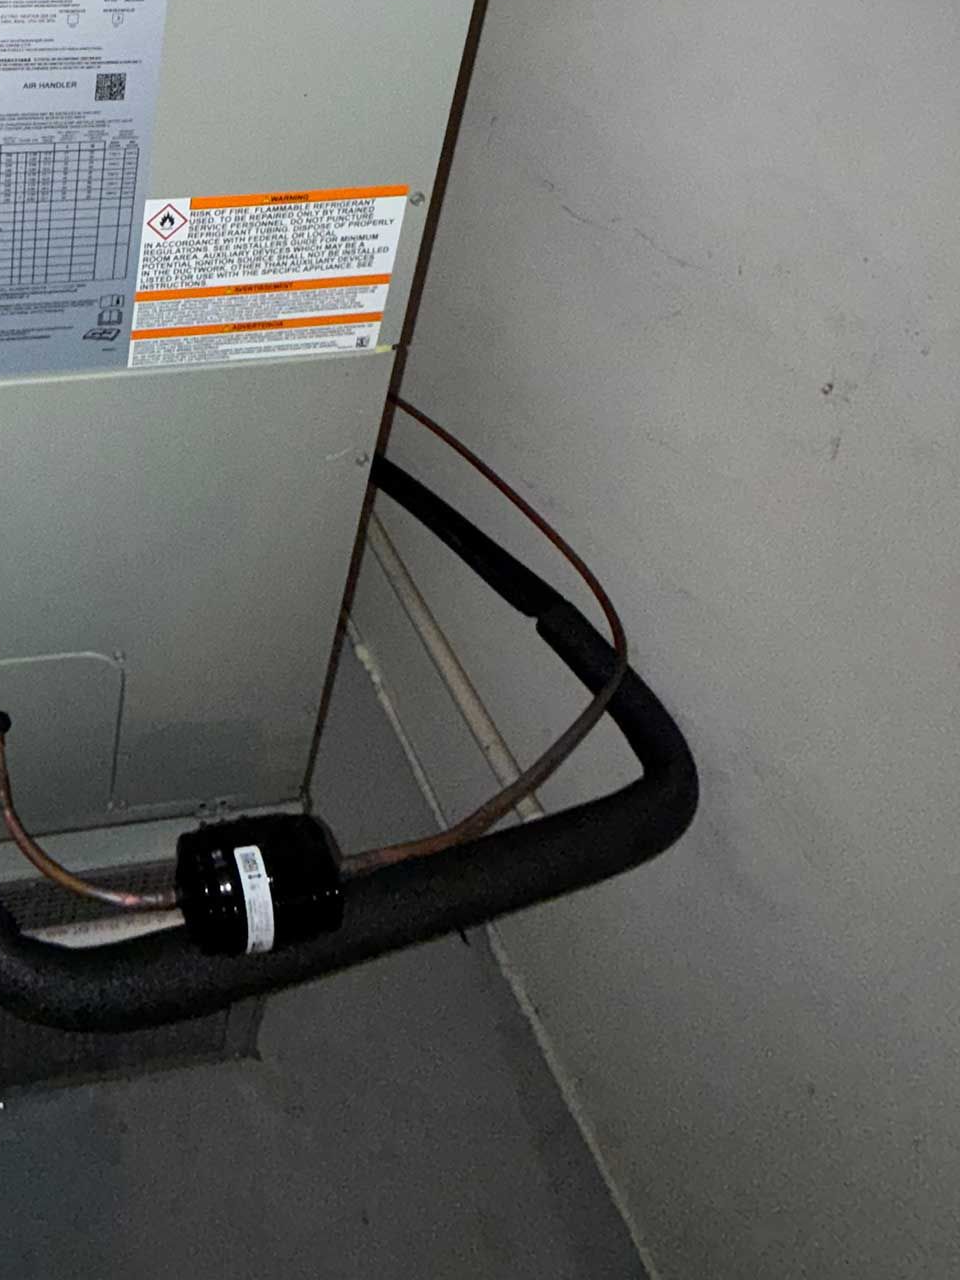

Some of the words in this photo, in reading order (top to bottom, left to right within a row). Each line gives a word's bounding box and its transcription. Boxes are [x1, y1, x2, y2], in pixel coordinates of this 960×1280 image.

[39, 81, 78, 89] HANDLER
[271, 194, 308, 202] WARNING
[249, 211, 294, 220] REPAIRED
[338, 206, 375, 214] TRAINED
[255, 204, 310, 213] FLAMMABLE
[314, 199, 376, 209] REFRIGERANT
[306, 216, 323, 224] NOT
[327, 213, 374, 222] PUNCTURE
[188, 229, 252, 238] REFRIGERANT
[293, 223, 332, 232] DISPOSE
[348, 219, 395, 228] PROPERLY
[156, 238, 220, 248] ACCORDANCE
[223, 236, 244, 244] WITH
[248, 234, 288, 242] FEDERAL
[290, 238, 315, 246] GUIDE
[319, 236, 338, 244] FOR
[142, 261, 191, 270] POTENTIAL
[195, 258, 234, 266] IGNITION
[238, 254, 275, 263] SOURCE
[277, 252, 303, 260] SHALL
[342, 246, 389, 256] INSTALLED
[203, 250, 248, 259] AUXILIARY
[252, 246, 290, 256] DEVICES
[294, 244, 320, 252] WHICH
[230, 263, 261, 271] OTHER
[265, 260, 288, 268] THAN
[290, 258, 336, 267] AUXILIARY
[338, 254, 374, 263] DEVICES
[140, 276, 172, 284] LISTED
[261, 267, 300, 275] SPECIFIC
